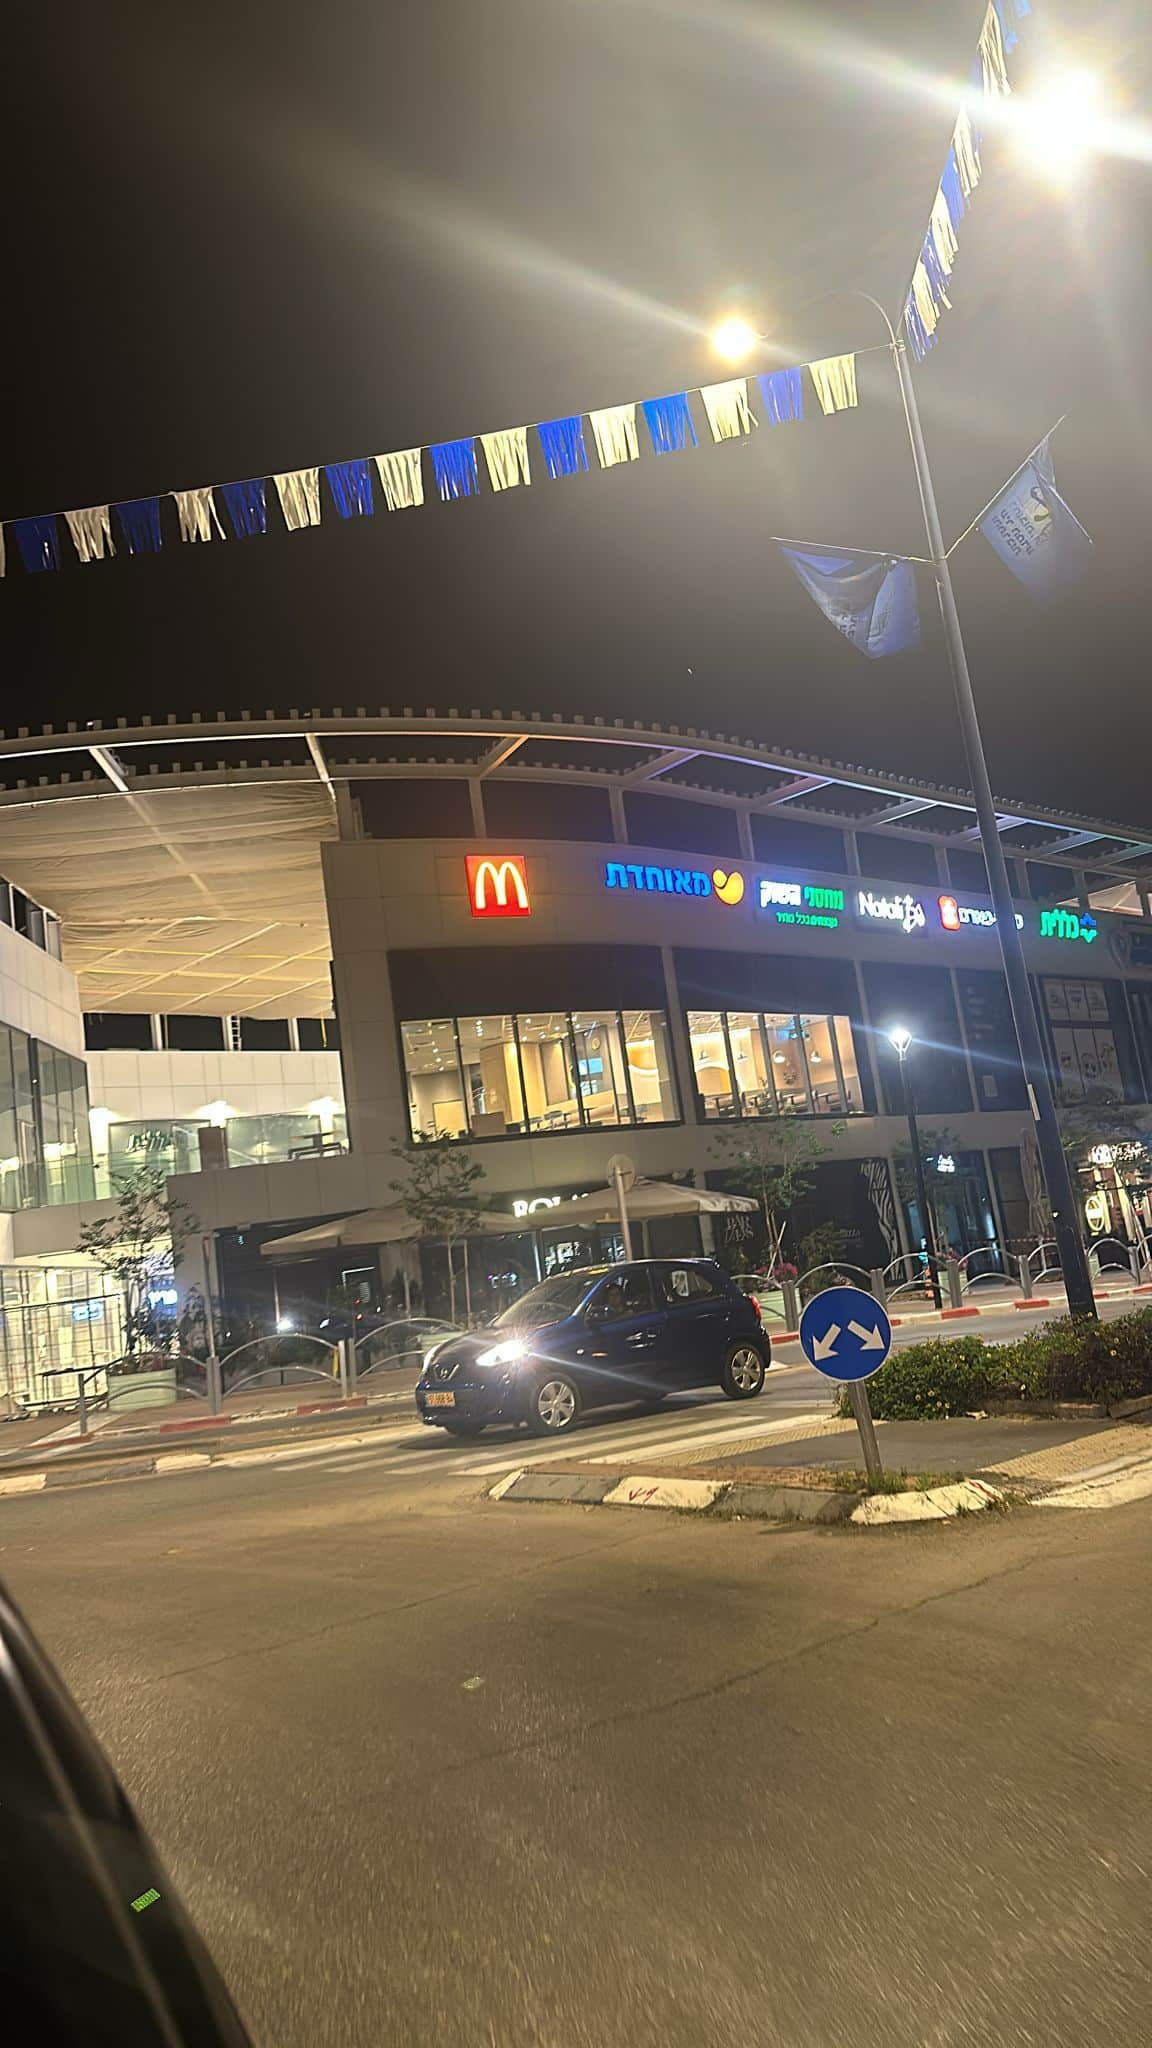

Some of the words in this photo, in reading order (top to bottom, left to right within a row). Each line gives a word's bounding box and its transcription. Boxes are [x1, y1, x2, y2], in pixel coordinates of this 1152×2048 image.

[605, 861, 712, 897] מאוחדת
[760, 880, 801, 908] השוק
[803, 886, 844, 911] מחסני
[1040, 908, 1079, 938] כללית
